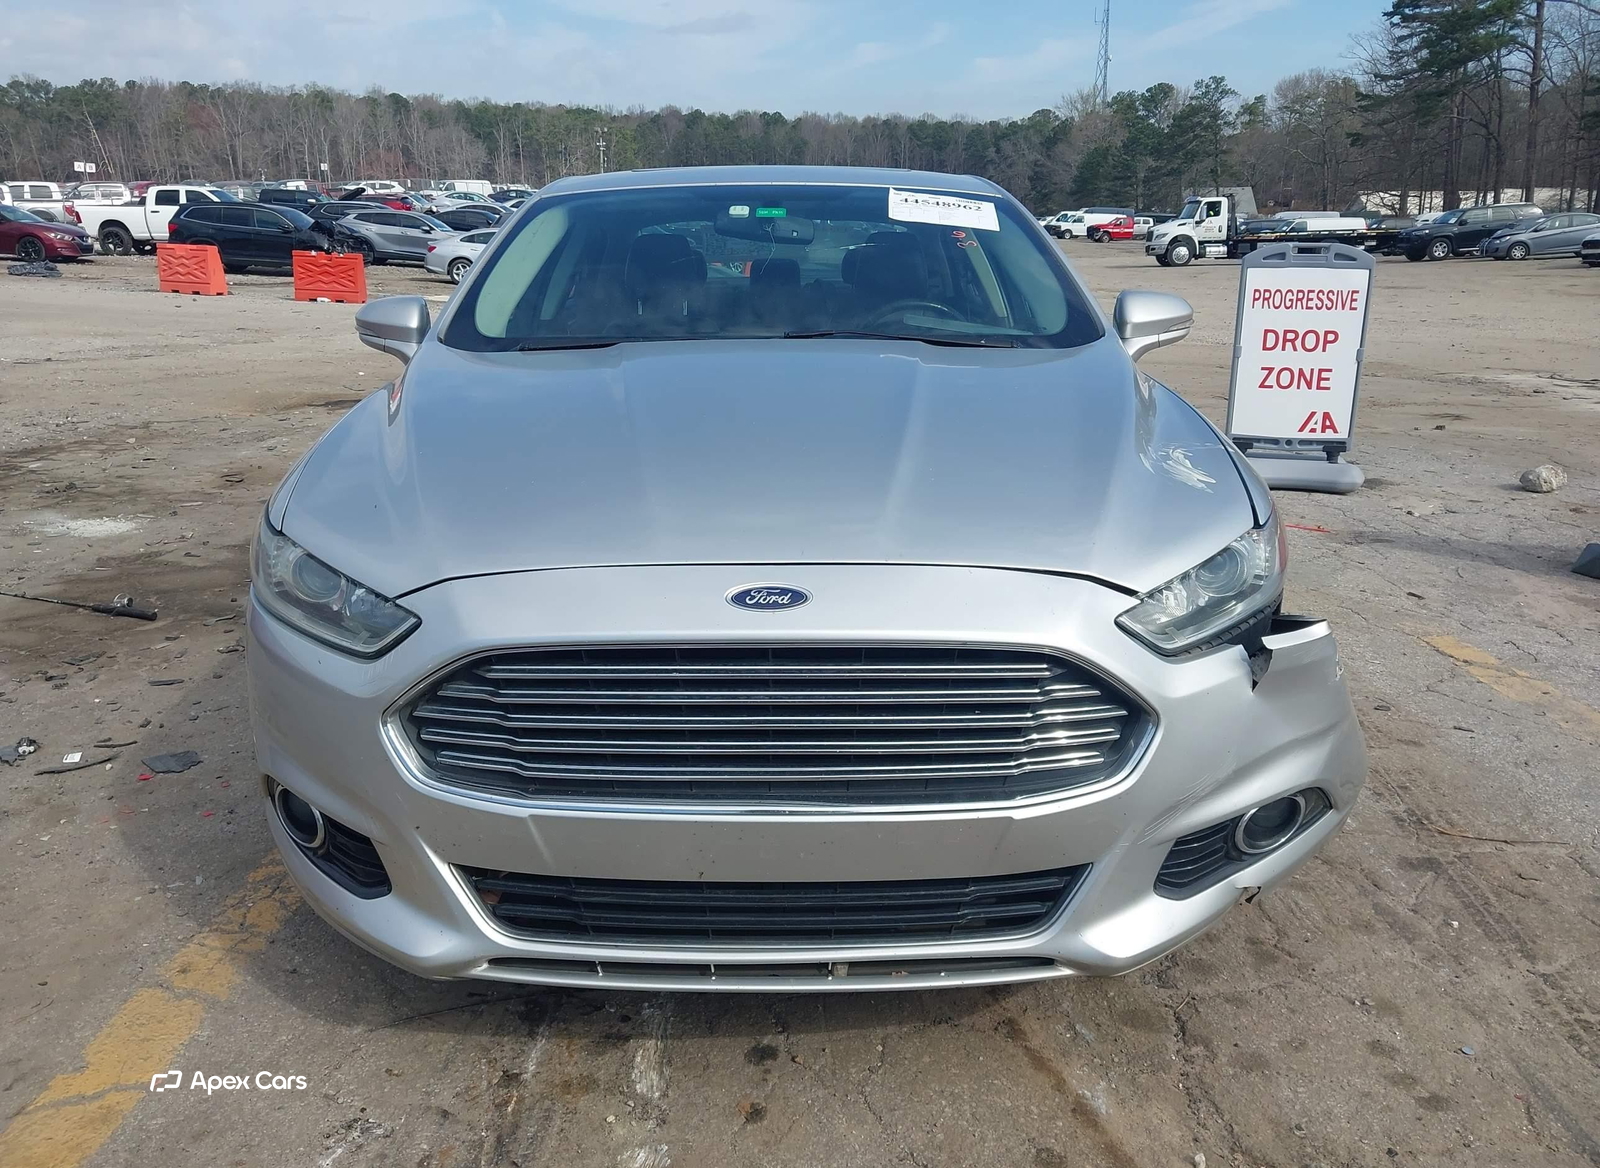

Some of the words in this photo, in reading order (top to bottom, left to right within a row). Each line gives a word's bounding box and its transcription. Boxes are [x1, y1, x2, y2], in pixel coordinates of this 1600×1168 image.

[899, 198, 984, 213] 44548962
[1251, 288, 1360, 311] PROGRESSIVE
[1261, 328, 1340, 353] DROP
[1257, 366, 1333, 391] ZONE
[745, 588, 792, 604] Ford
